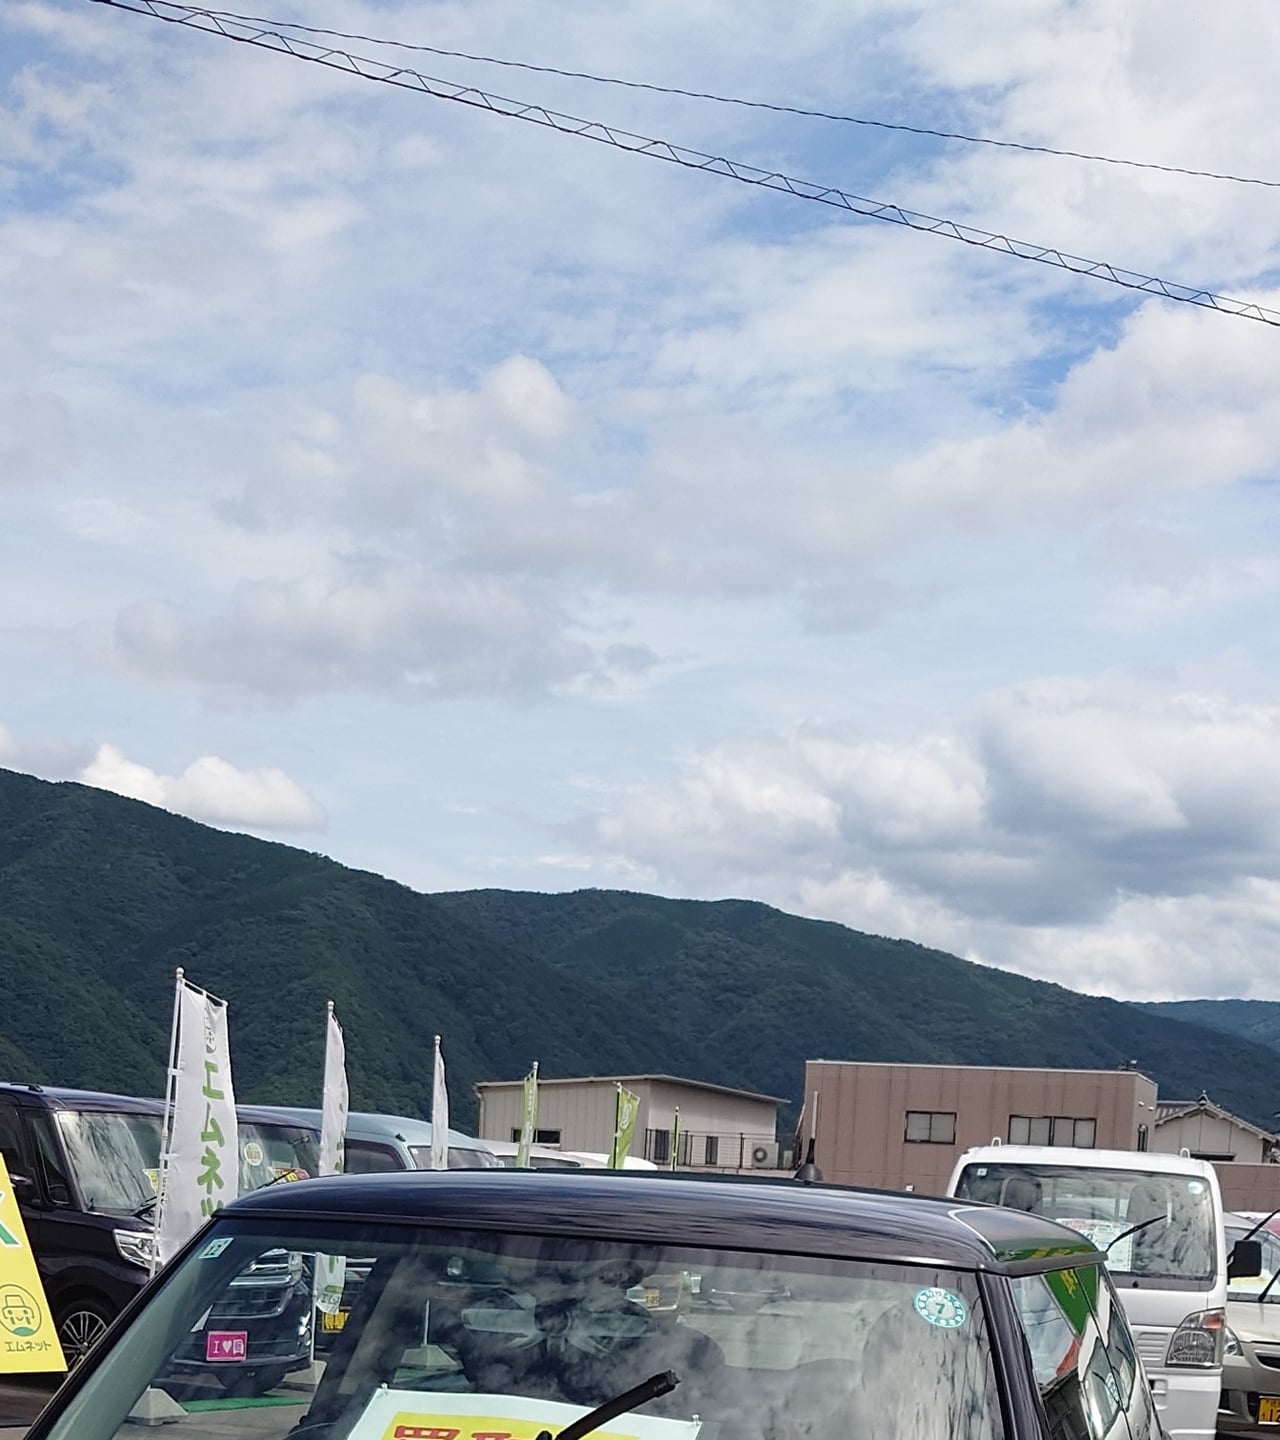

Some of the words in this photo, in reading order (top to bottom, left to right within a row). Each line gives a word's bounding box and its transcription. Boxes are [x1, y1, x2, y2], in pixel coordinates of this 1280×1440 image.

[5, 1340, 53, 1353] エムネット
